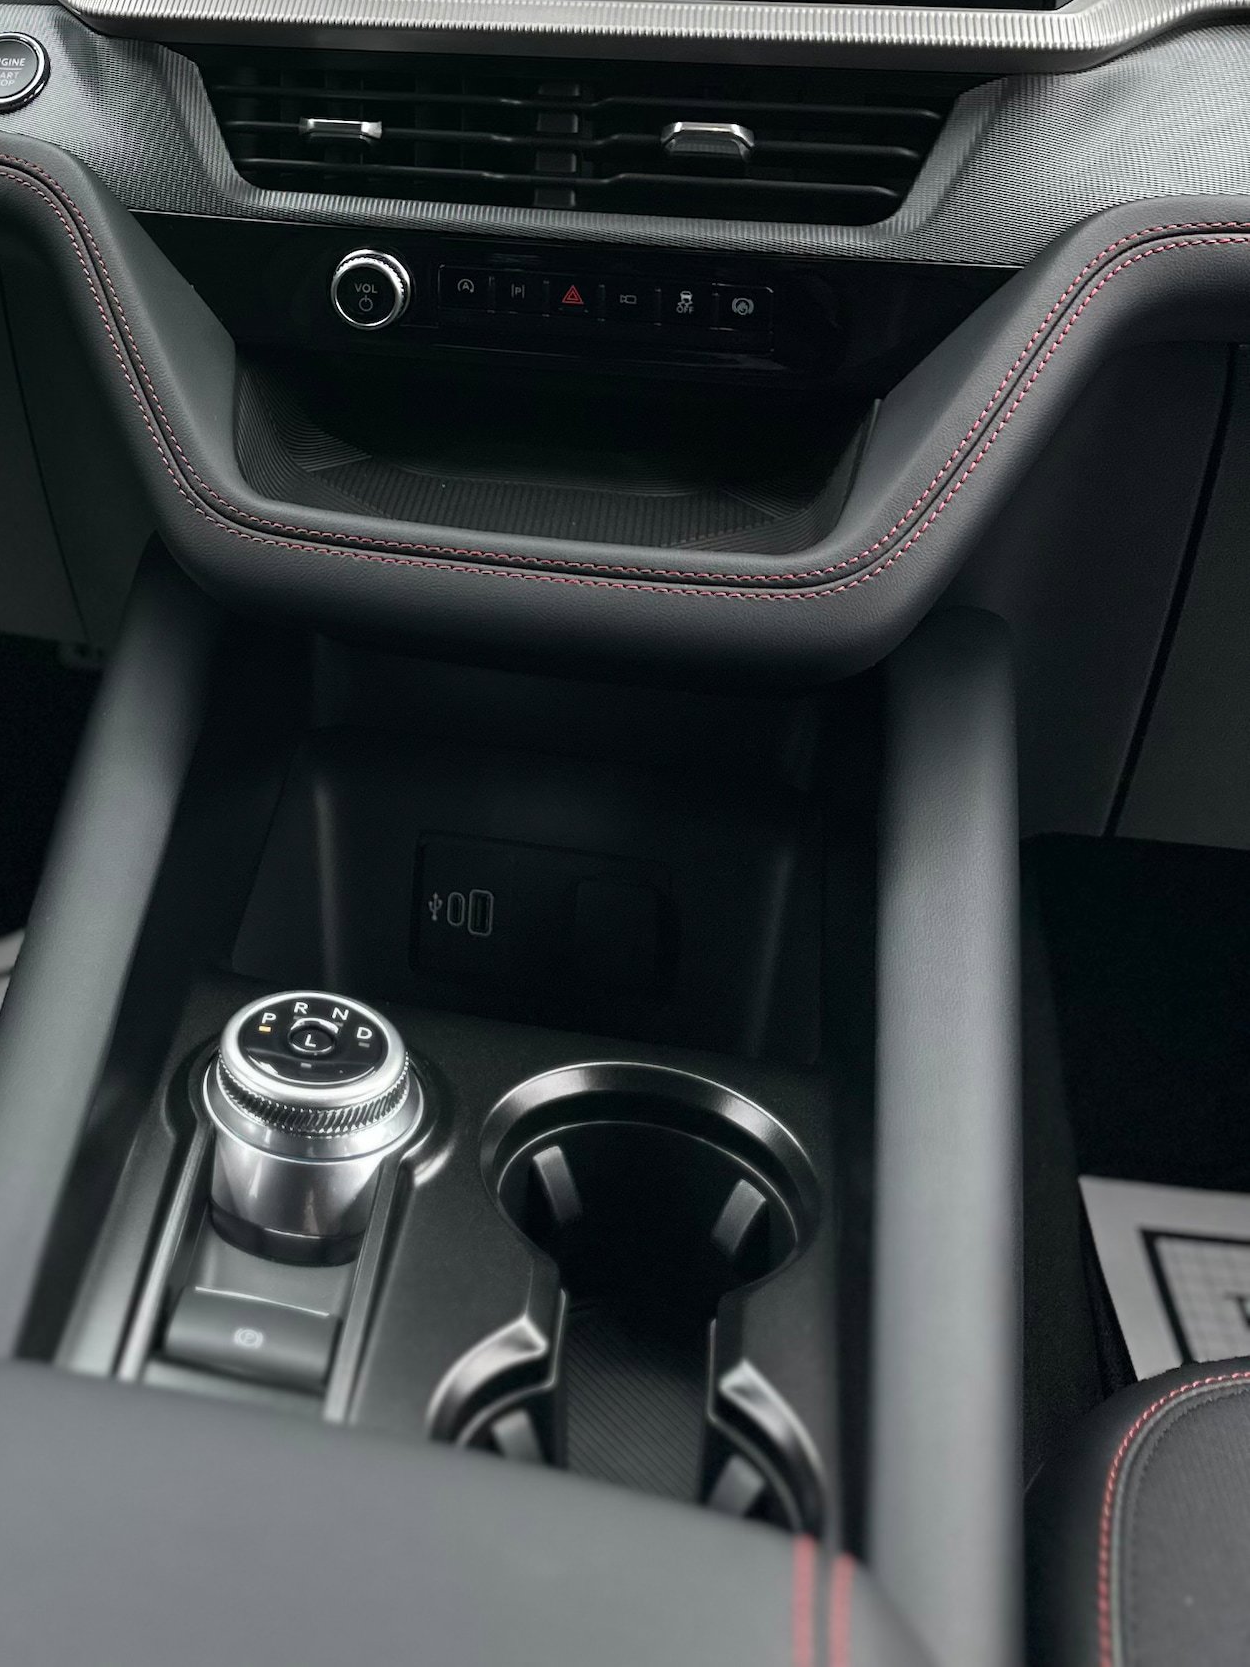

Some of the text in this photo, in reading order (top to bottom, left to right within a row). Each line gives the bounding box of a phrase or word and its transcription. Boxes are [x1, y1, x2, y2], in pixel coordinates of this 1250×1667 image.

[354, 284, 378, 294] VOL
[676, 305, 694, 314] OFF
[293, 1001, 309, 1015] R
[331, 1007, 349, 1022] N
[261, 1012, 277, 1025] P
[356, 1026, 373, 1040] D
[304, 1034, 317, 1048] L
